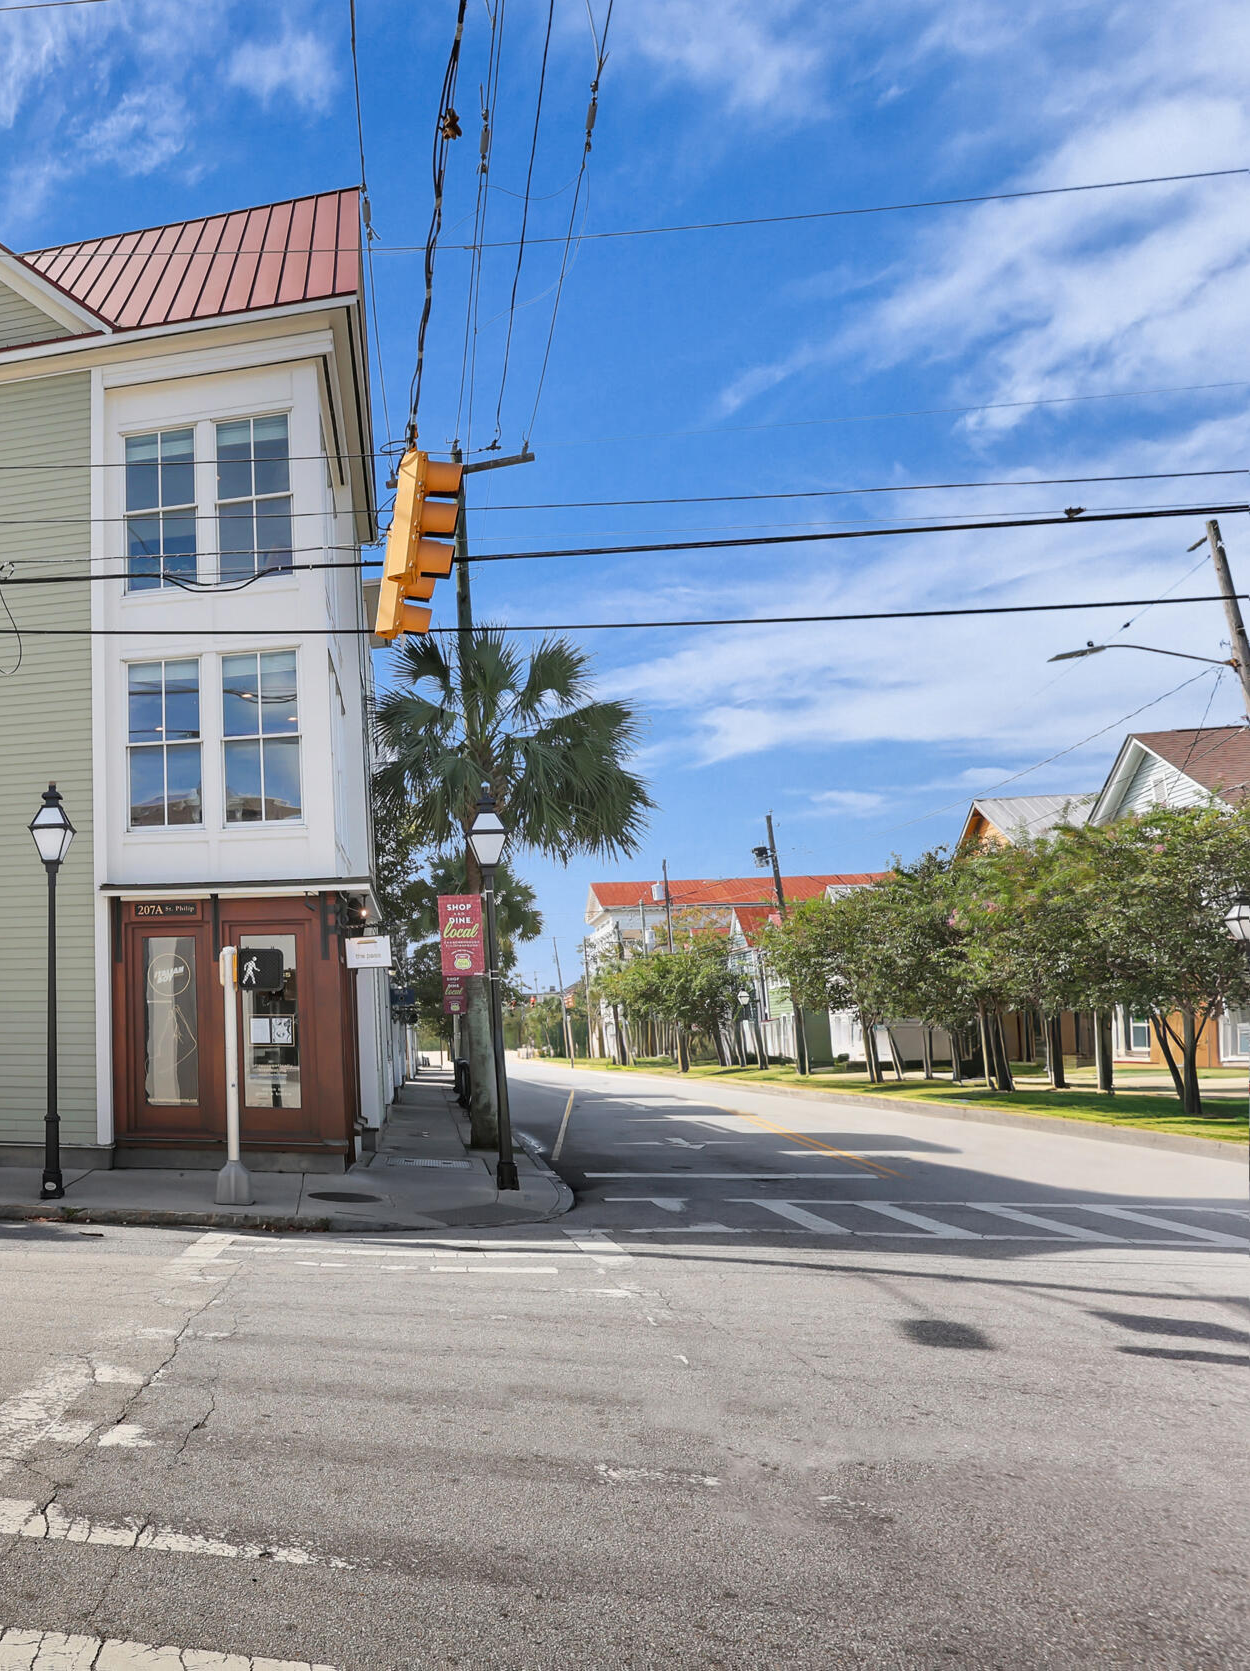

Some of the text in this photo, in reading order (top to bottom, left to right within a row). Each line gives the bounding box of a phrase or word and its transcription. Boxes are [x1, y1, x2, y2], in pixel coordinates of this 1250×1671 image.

[138, 904, 164, 915] 207A
[446, 903, 471, 911] SHOP
[443, 921, 479, 938] local
